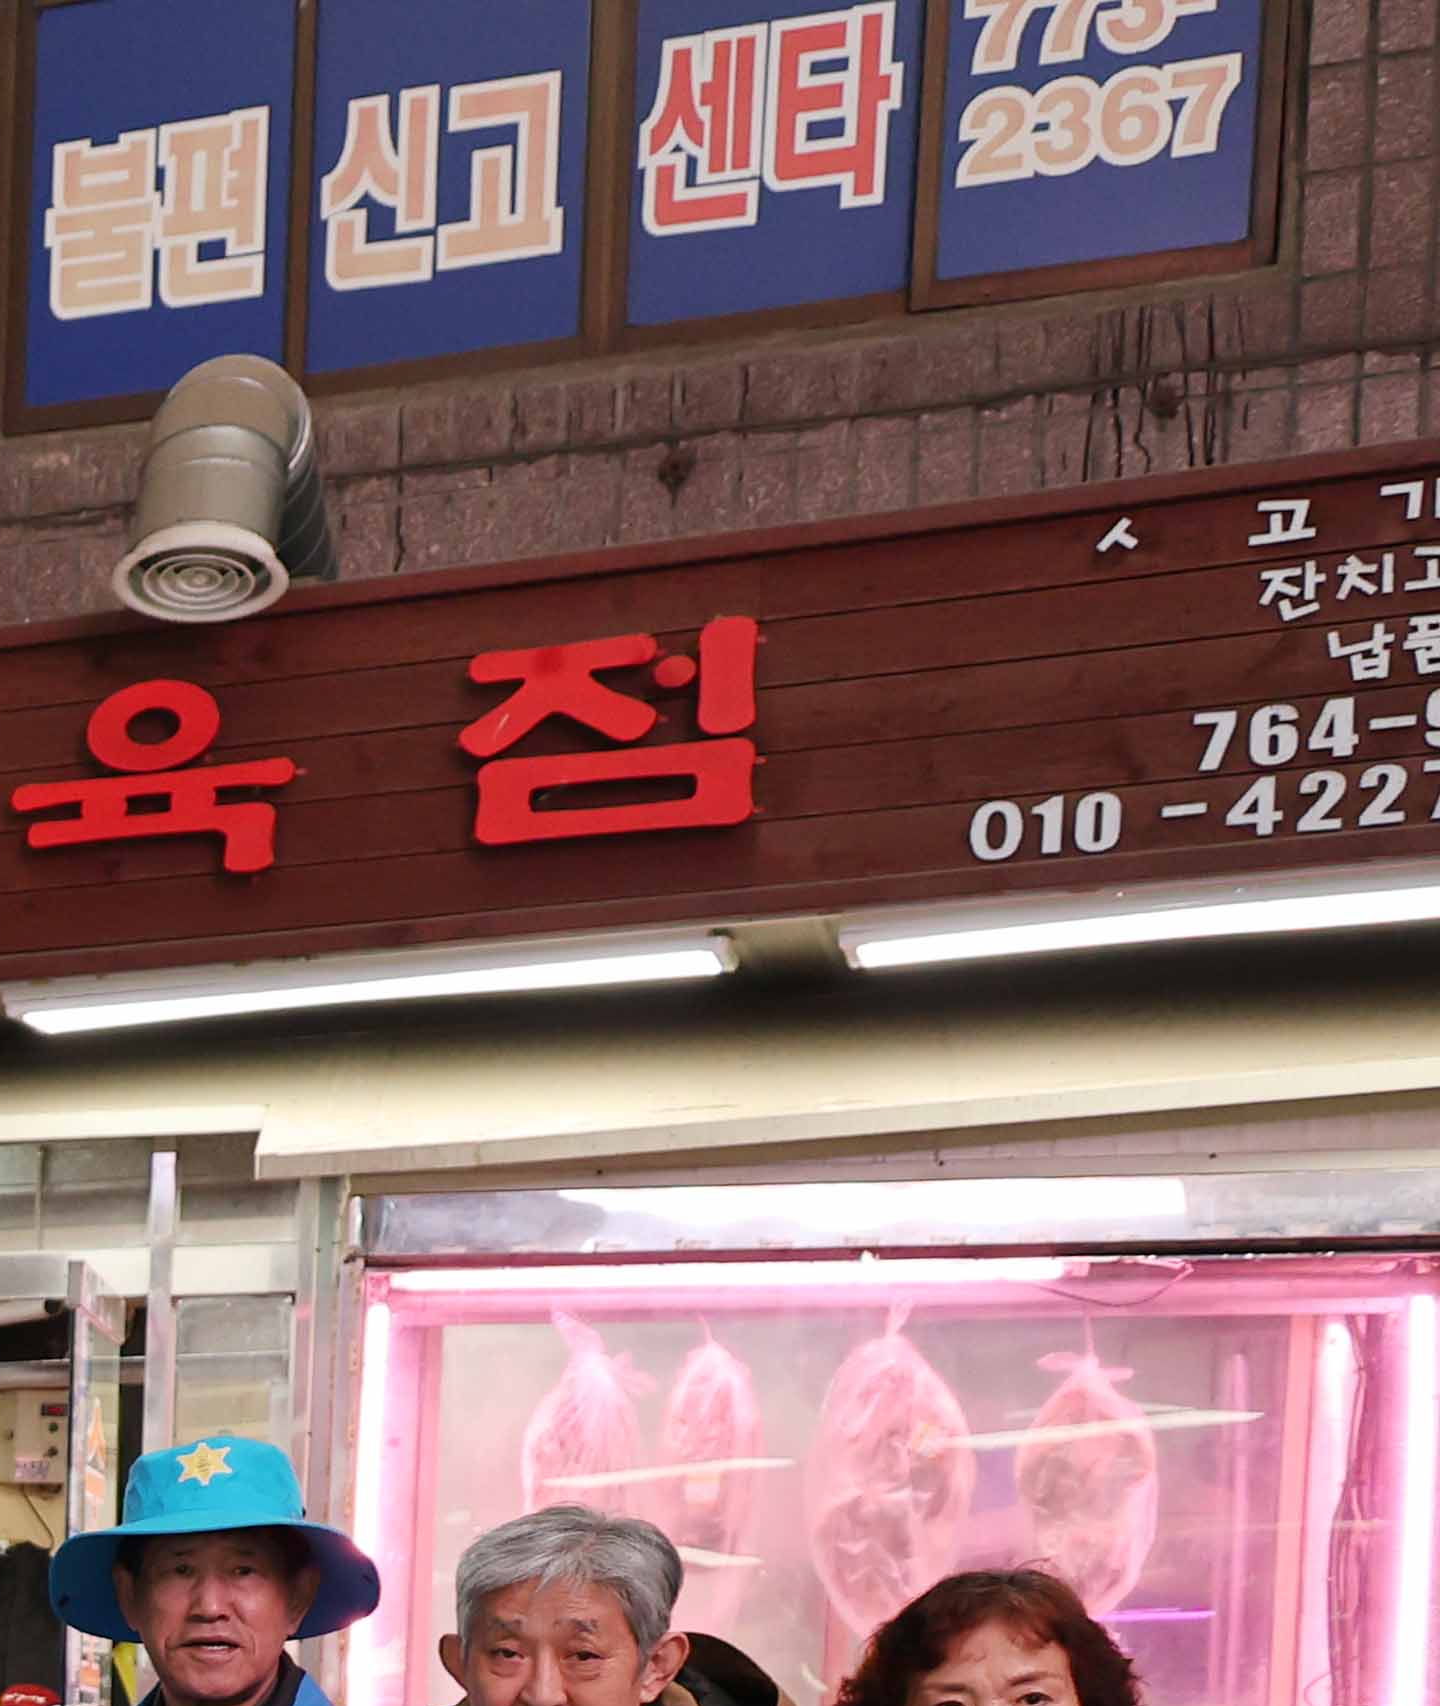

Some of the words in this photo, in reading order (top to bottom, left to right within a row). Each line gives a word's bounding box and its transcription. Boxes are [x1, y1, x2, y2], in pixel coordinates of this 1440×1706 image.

[46, 104, 272, 321] 불편
[321, 69, 564, 292] 신고
[640, 0, 902, 238] 센타
[957, 51, 1244, 190] 2367
